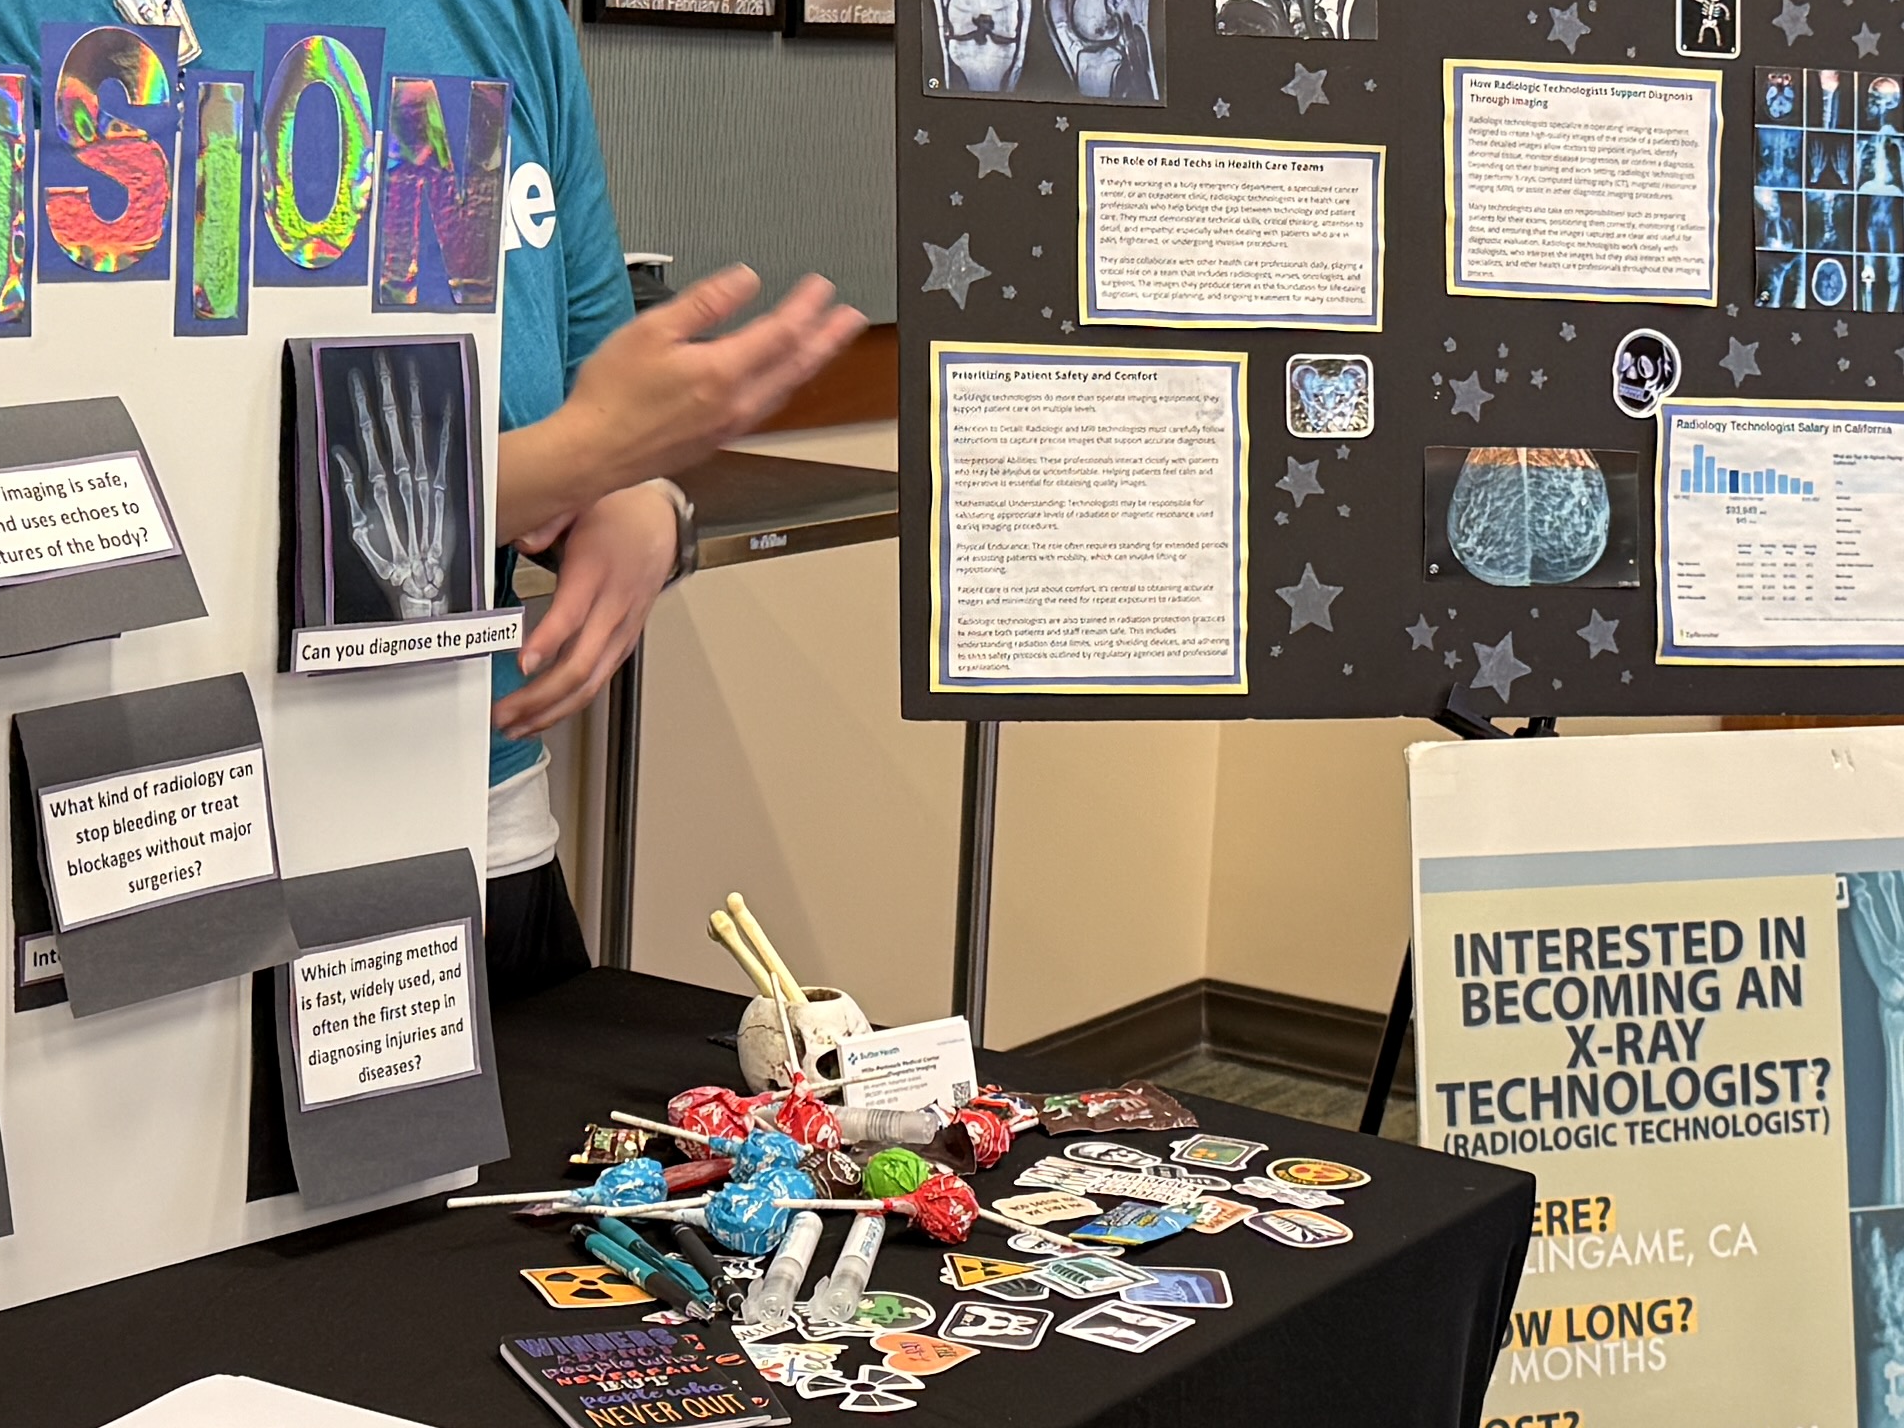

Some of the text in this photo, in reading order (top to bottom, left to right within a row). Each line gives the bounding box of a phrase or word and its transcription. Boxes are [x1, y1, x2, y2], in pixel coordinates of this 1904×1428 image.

[1099, 155, 1323, 171] The Role of Rad Techs in Health Care Teams
[951, 370, 1157, 382] Prioritizing Patient Safety and Comfort
[1676, 418, 1892, 435] Radiology Technologist Salary in California
[0, 481, 67, 501] imaging
[67, 478, 83, 493] is
[87, 471, 127, 490] safe,
[20, 514, 56, 529] uses
[60, 505, 119, 524] echoes
[121, 501, 139, 514] to
[47, 539, 63, 556] of
[66, 537, 95, 554] the
[97, 526, 148, 549] body?
[301, 622, 517, 662] Can you diagnose the patient?
[49, 763, 253, 818] What kind of radiology can
[75, 794, 239, 844] stop bleeding or treat
[66, 821, 251, 876] blockages without major
[128, 859, 201, 893] surgeries?
[300, 935, 457, 982] Which imaging method
[1454, 916, 1805, 977] INTERESTED IN
[301, 962, 461, 1010] is fast, widely used, and
[1462, 964, 1801, 1026] BECOMING AN
[312, 993, 455, 1036] often the first step in
[308, 1017, 463, 1066] diagnosing injuries and
[1566, 1017, 1704, 1068] X-RAY
[358, 1054, 421, 1083] diseases?
[1436, 1059, 1831, 1128] TECHNOLOGIST?
[1443, 1106, 1828, 1156] (RADIOLOGIC TECHNOLOGIST)
[1708, 1222, 1758, 1258] CA
[515, 1328, 678, 1358] WINNERS
[1566, 1297, 1693, 1344] LONG?
[1510, 1338, 1667, 1385] MONTHS
[585, 1393, 747, 1428] NEVER QUIT
